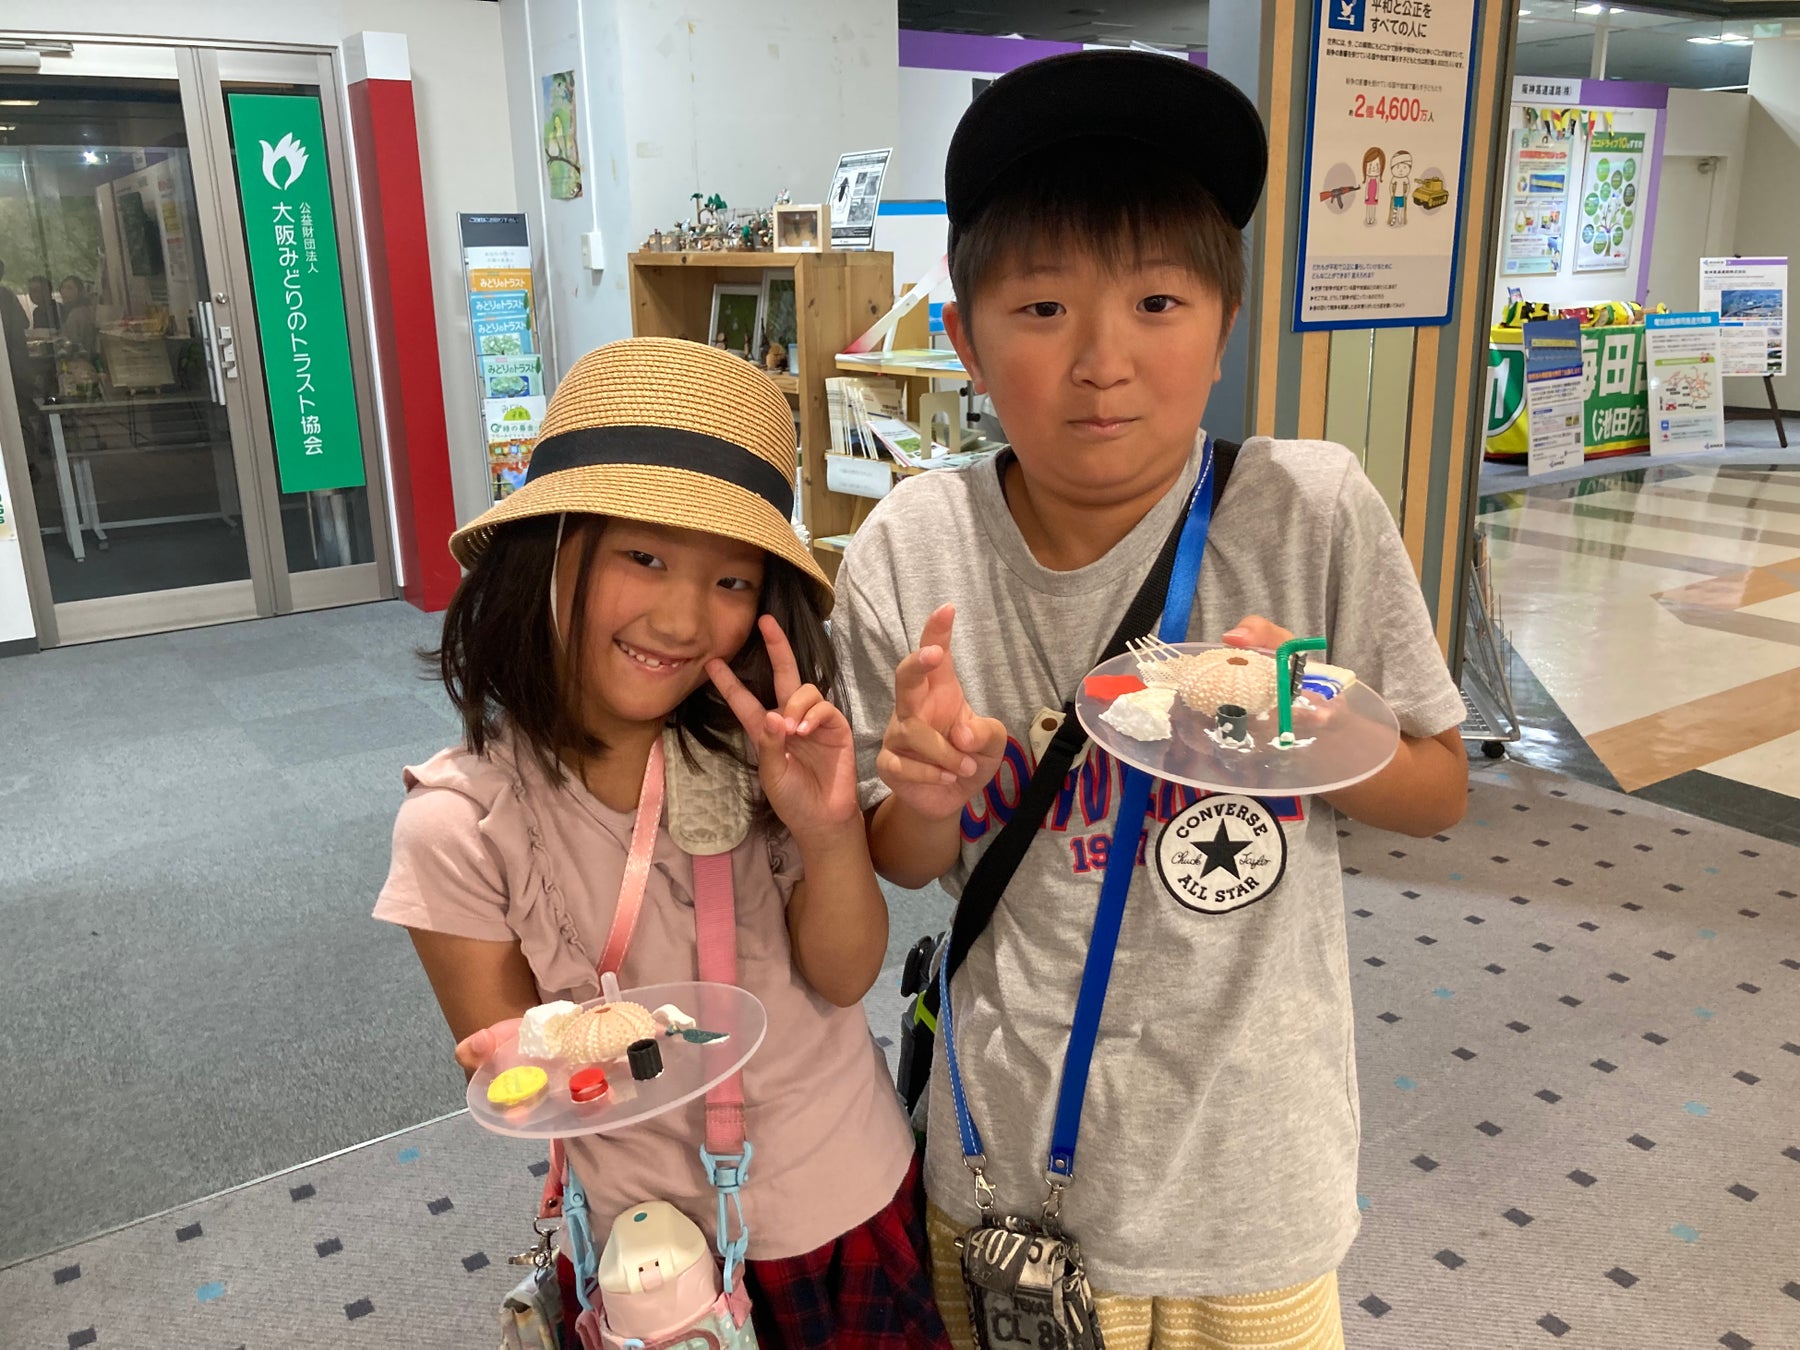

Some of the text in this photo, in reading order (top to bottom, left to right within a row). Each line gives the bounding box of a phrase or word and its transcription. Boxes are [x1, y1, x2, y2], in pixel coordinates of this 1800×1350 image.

[1371, 0, 1432, 19] 平和と公正を
[1370, 17, 1428, 38] すべての人に
[299, 201, 319, 274] 公益財団法人
[479, 277, 526, 289] みどりのトラスト
[476, 299, 524, 312] みどりのトラスト
[271, 200, 324, 456] 大阪みどりのトラスト協会
[478, 321, 526, 334] みどりのトラスト
[488, 363, 536, 375] みどりのトラスト
[1592, 405, 1650, 442] (池田方
[1175, 802, 1268, 839] CONVERSE
[1171, 850, 1271, 867] Chuck Taylor
[1178, 874, 1261, 903] ALL STAR
[970, 1228, 1026, 1271] 407
